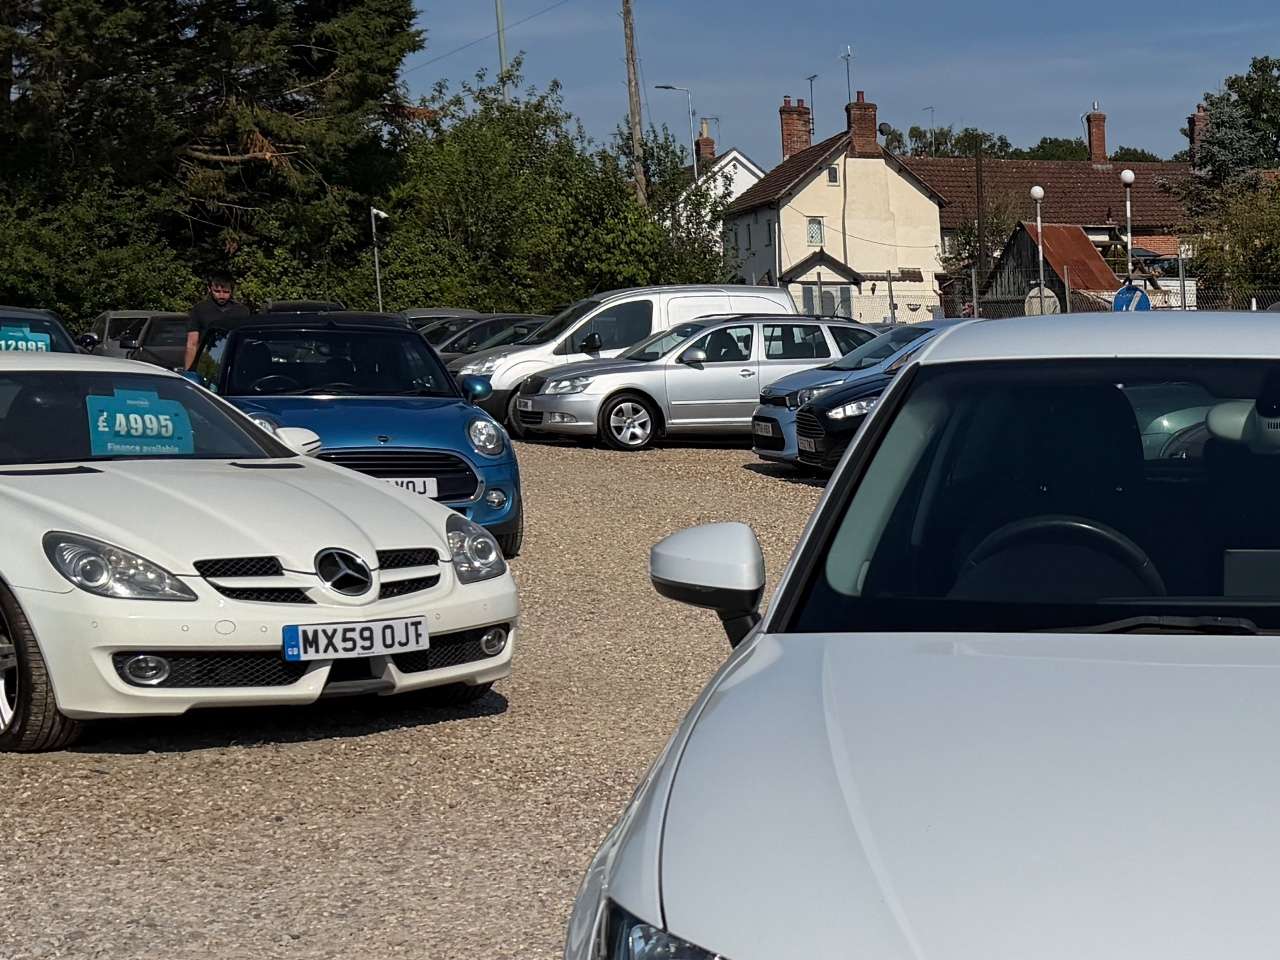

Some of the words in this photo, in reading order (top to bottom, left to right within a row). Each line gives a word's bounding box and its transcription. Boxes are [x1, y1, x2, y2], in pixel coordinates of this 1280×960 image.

[0, 339, 46, 352] 12995
[114, 413, 174, 437] 4995
[301, 626, 375, 655] MX59
[381, 620, 422, 649] OJT
